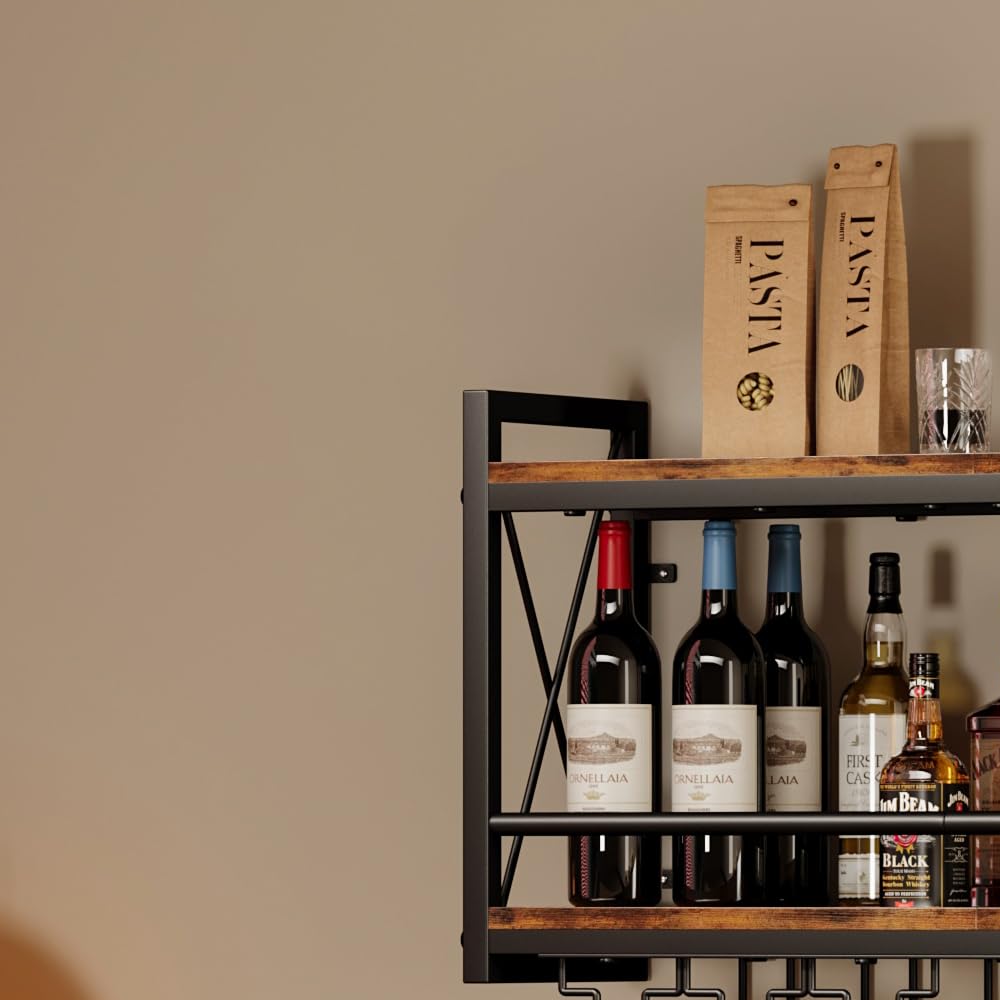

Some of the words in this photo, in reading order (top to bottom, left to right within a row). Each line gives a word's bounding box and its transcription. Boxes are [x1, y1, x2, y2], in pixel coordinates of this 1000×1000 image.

[735, 236, 743, 264] SPAGHETTI
[846, 216, 875, 338] PASTA
[748, 239, 784, 354] PASTA
[847, 754, 883, 768] FIRST
[569, 773, 629, 784] ORNELLAIA
[674, 774, 734, 785] ORNELLAIA
[883, 853, 929, 868] BLACK
